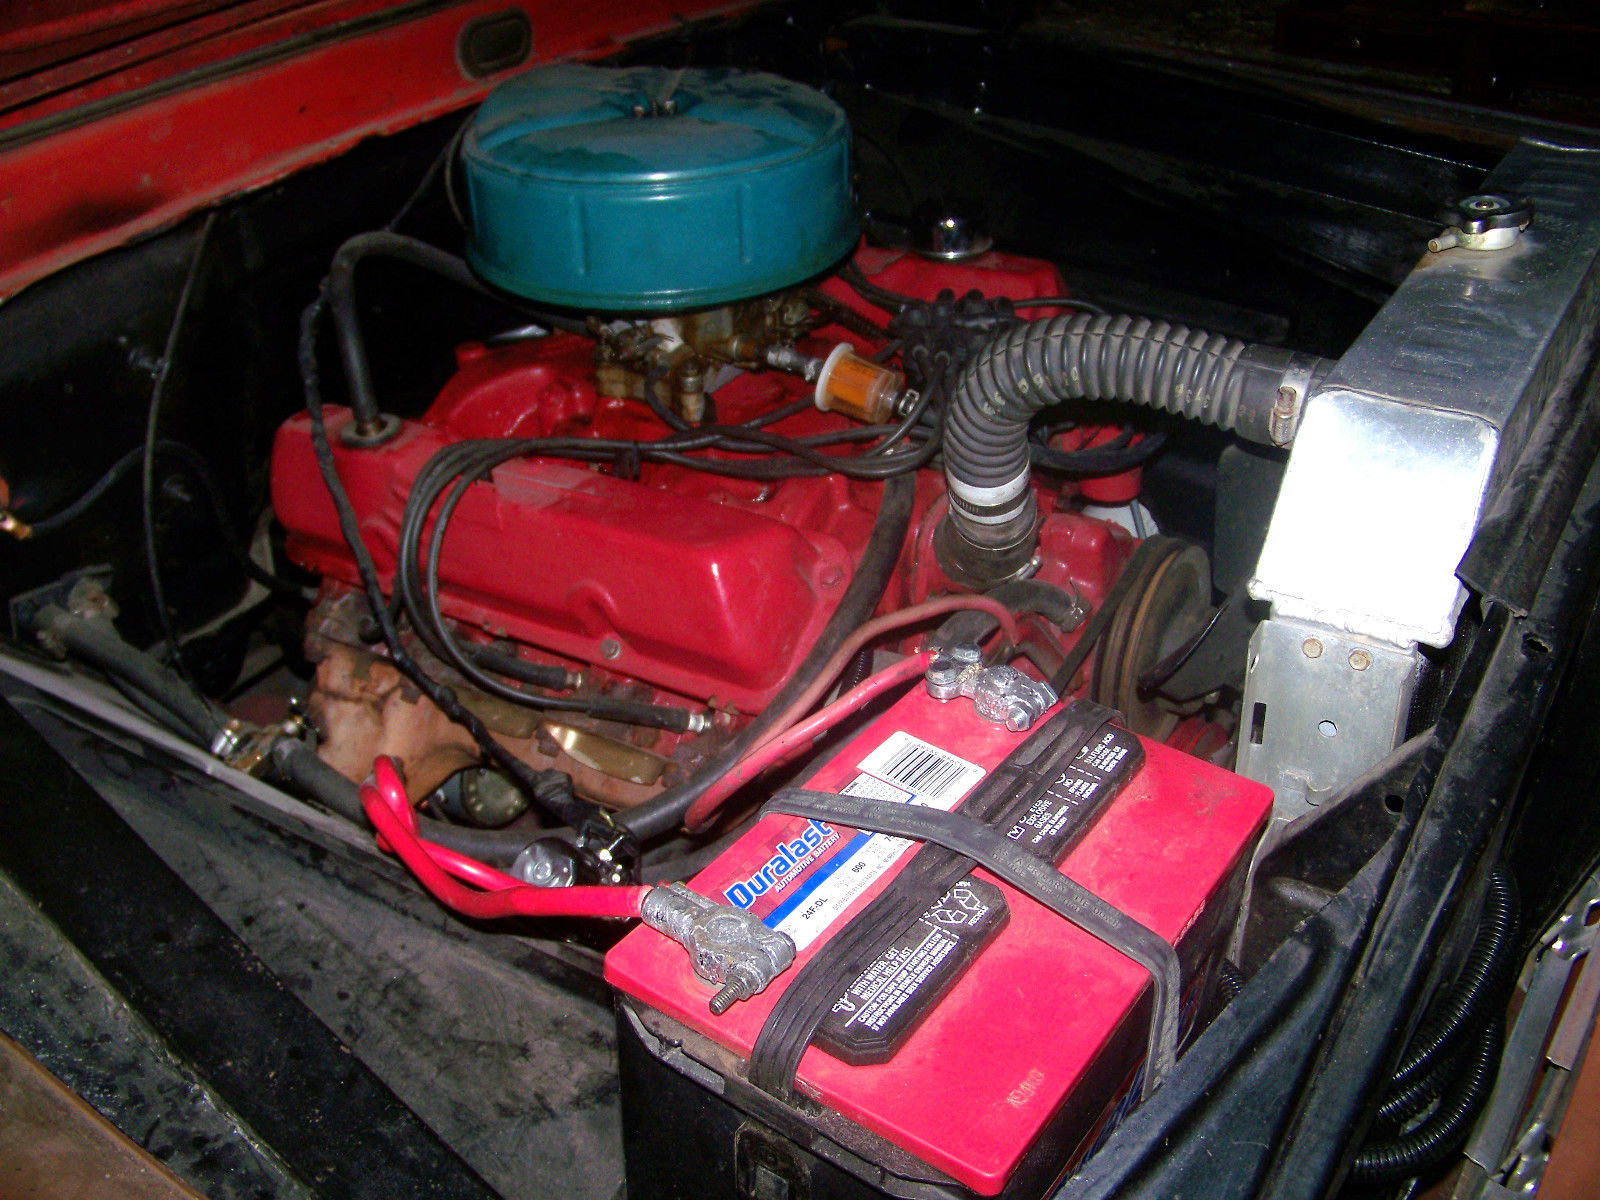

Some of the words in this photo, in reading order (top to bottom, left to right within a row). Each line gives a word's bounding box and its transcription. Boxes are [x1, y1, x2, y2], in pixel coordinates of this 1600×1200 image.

[1101, 733, 1114, 745] ACID
[1062, 778, 1074, 788] NO
[1024, 798, 1053, 826] EXPLOSIVE
[1032, 811, 1052, 828] GASES
[723, 819, 834, 909] Duralast
[774, 854, 816, 893] AUTOMOTIVE
[812, 831, 841, 858] BATTERY
[802, 897, 828, 919] 24F-DL
[967, 904, 989, 926] RECYCLE
[850, 977, 871, 996] WITH
[883, 946, 900, 961] GET
[859, 974, 887, 1000] MEDICAL
[881, 959, 900, 976] HELP
[894, 945, 913, 963] FAST
[875, 990, 889, 1003] FOR
[883, 980, 898, 994] SAFE
[904, 949, 928, 971] STARTING
[922, 933, 943, 952] FOLLOW
[914, 964, 935, 984] SERVICE
[863, 993, 897, 1026] INSTRUCTIONS
[891, 988, 903, 997] IN
[897, 972, 917, 991] VEHICLE
[904, 981, 919, 995] SEEK
[884, 991, 909, 1017] AVAILABLE
[871, 1023, 880, 1031] IF
[875, 1013, 889, 1026] NOT
